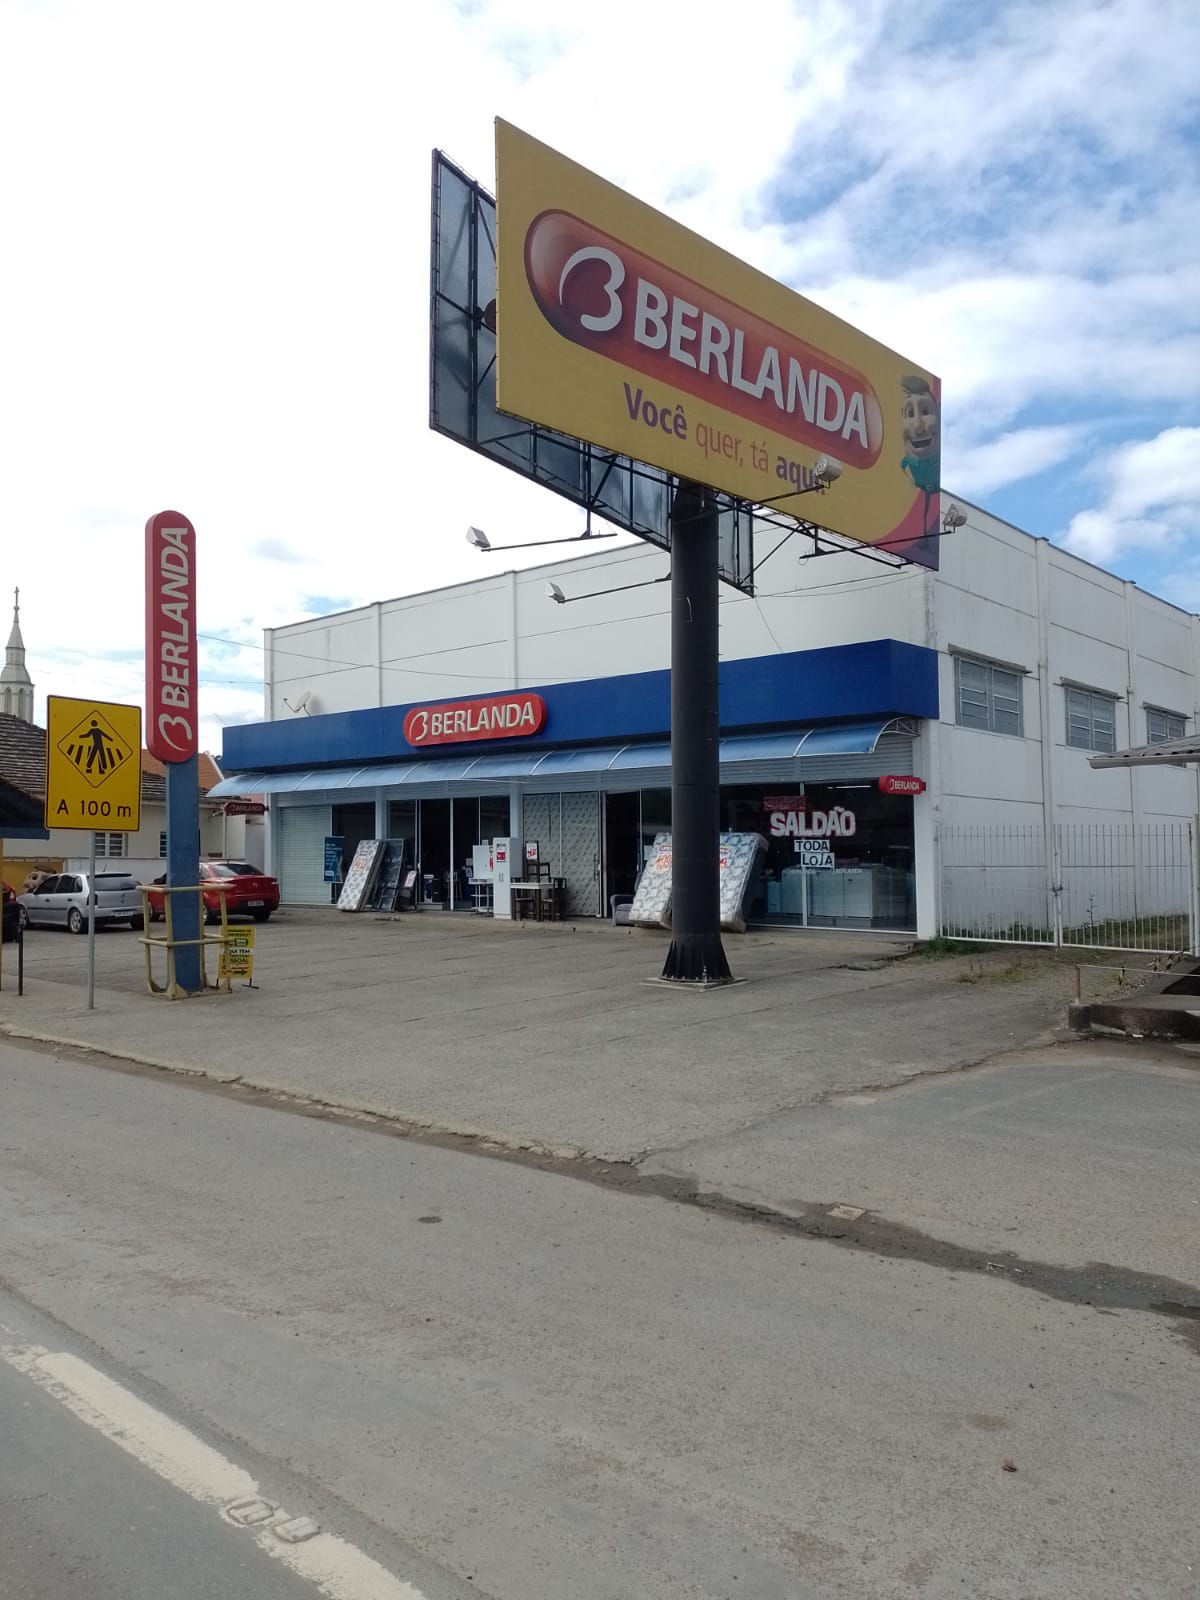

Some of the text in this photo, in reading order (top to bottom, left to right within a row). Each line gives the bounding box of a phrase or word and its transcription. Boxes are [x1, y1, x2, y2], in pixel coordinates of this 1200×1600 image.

[633, 277, 869, 449] BERLANDA
[623, 382, 825, 496] Você quer, tá aqu
[160, 527, 189, 709] BERLANDA
[431, 701, 535, 736] BERLANDA
[894, 780, 920, 790] BERLANDA
[57, 799, 132, 818] A 100 m
[770, 806, 856, 837] SALDÃO
[795, 840, 829, 852] TODA
[802, 853, 833, 866] LOJA
